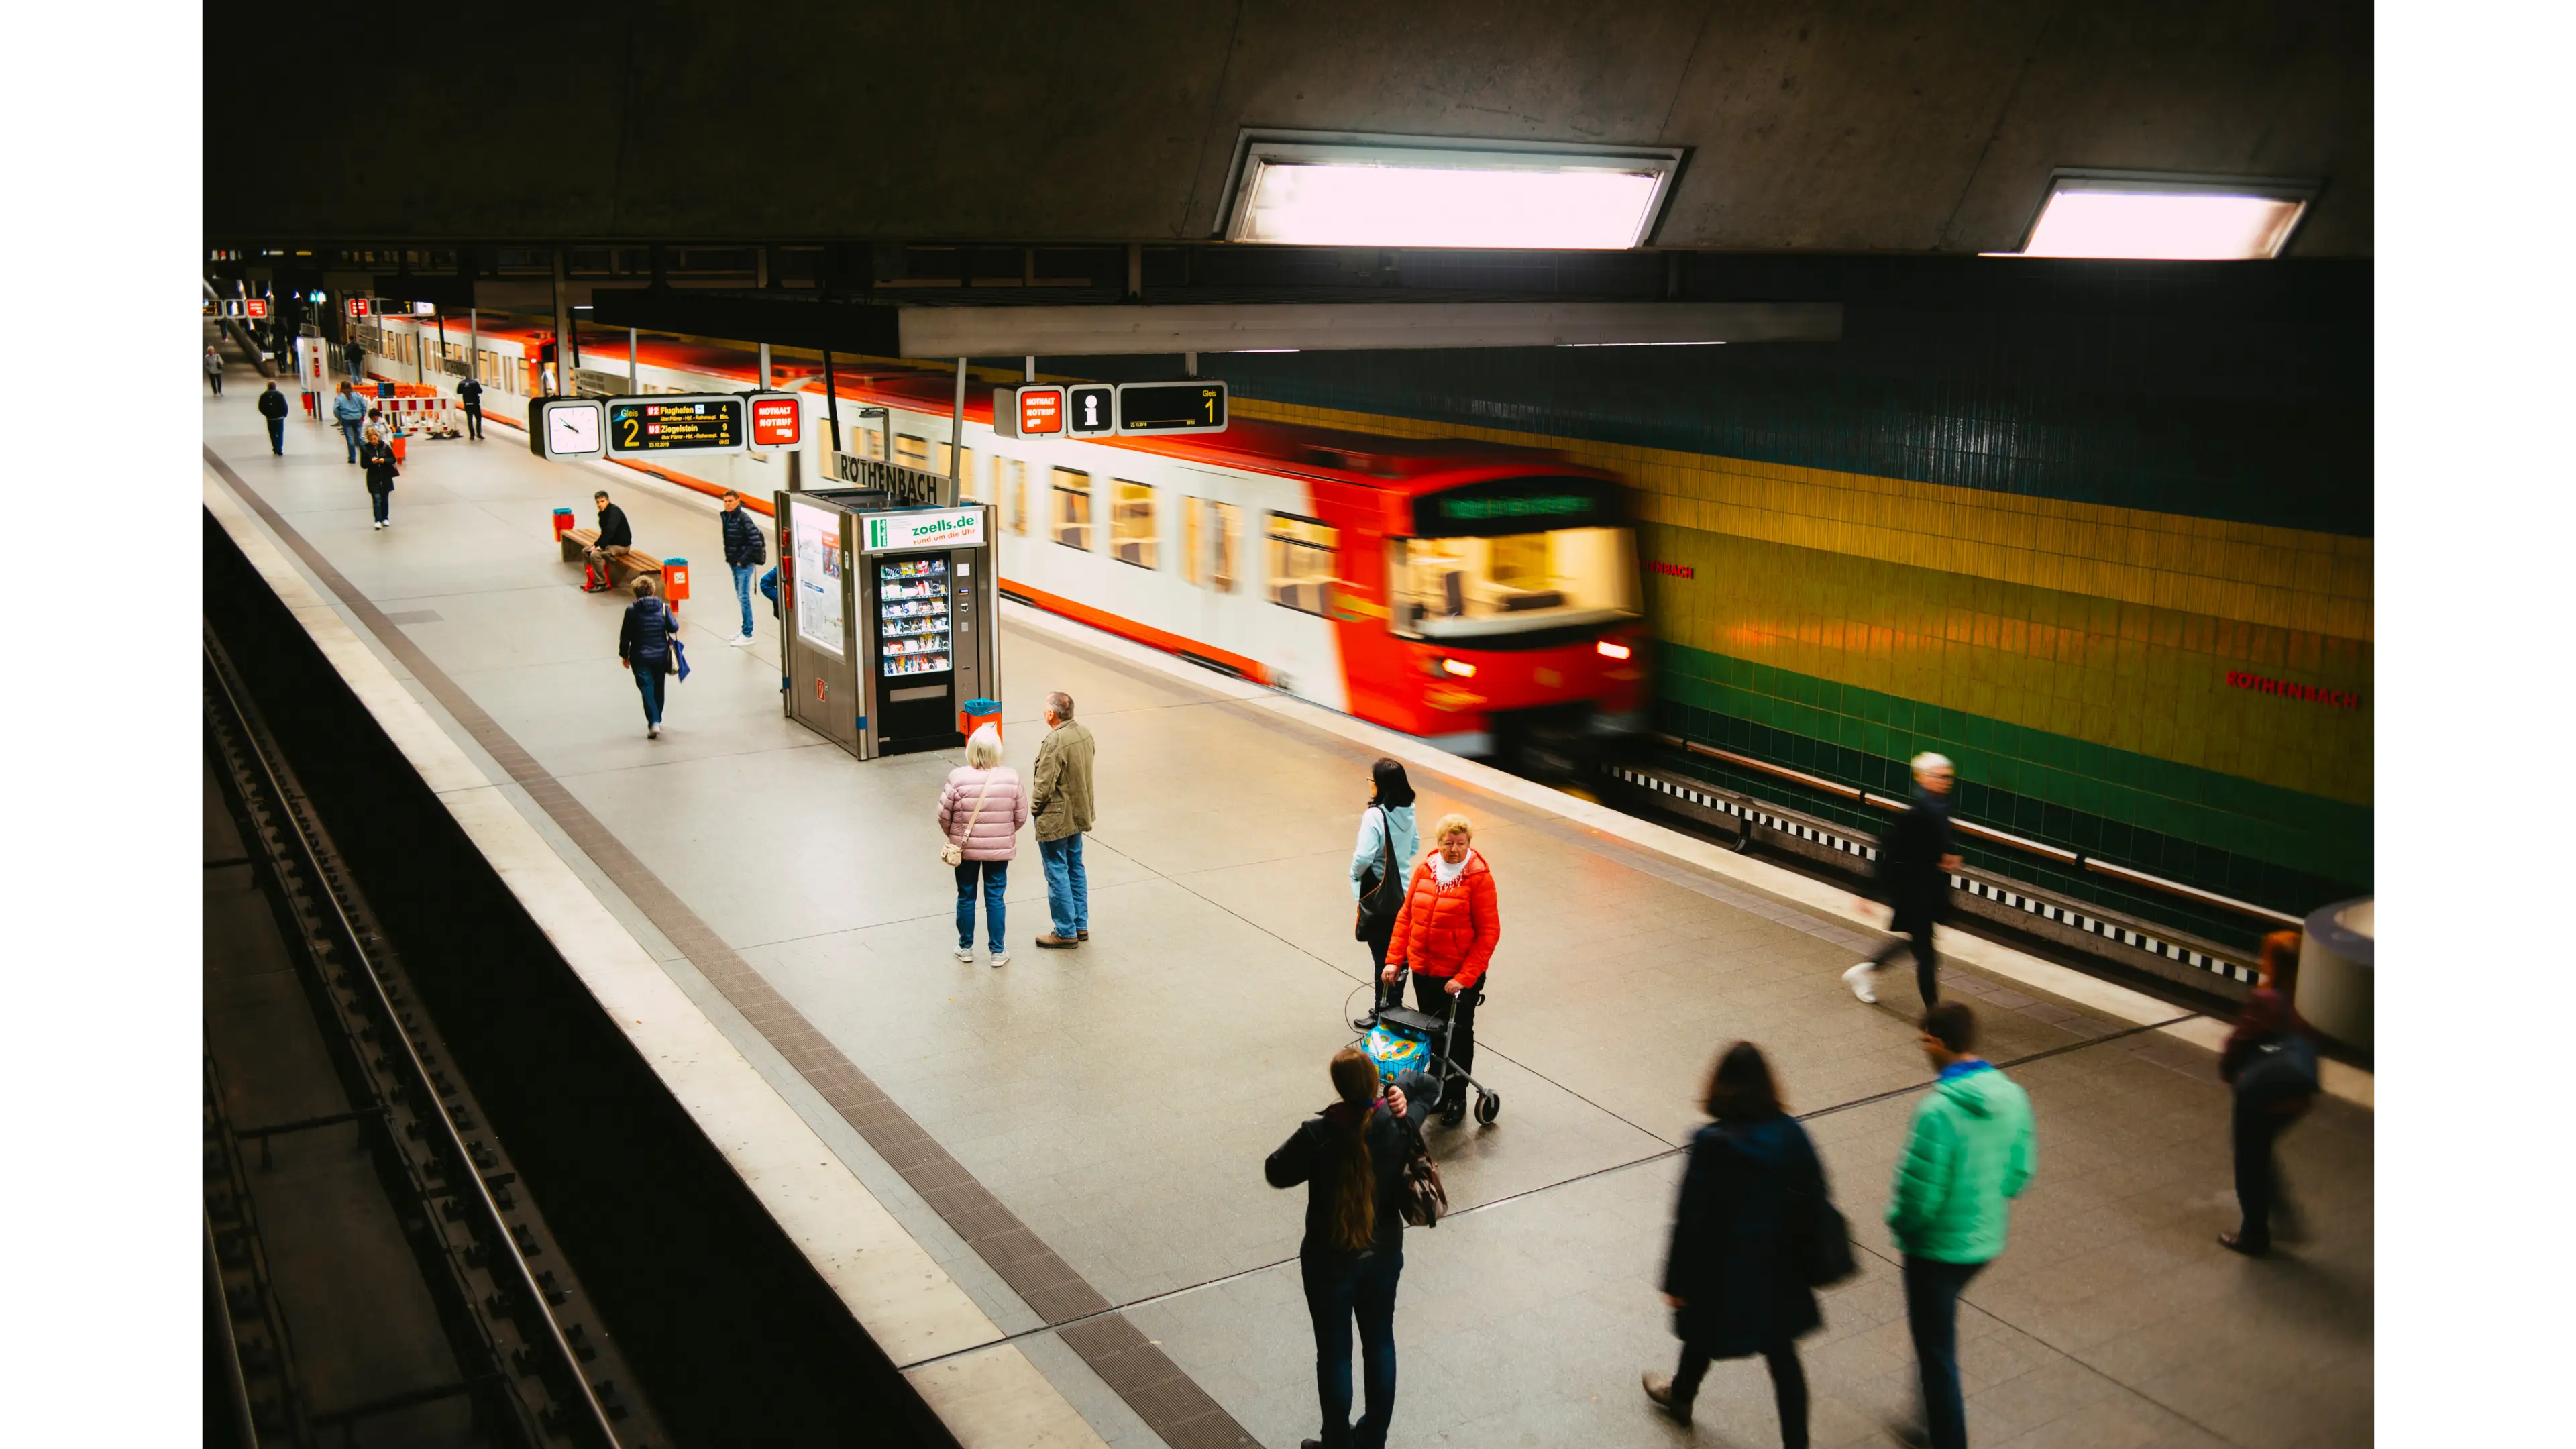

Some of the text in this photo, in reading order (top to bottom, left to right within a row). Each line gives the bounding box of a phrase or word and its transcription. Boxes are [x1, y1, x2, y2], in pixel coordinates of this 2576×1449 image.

[1026, 397, 1055, 406] NOTHALT
[621, 409, 639, 417] Gleis
[647, 406, 694, 416] U2 Flughafen
[722, 405, 727, 413] 4
[759, 407, 791, 415] NOTHALT
[1026, 408, 1055, 416] NOTRUF
[1205, 398, 1213, 423] 1
[722, 423, 728, 431] 9
[759, 417, 792, 427] NOTRUF
[624, 419, 639, 447] 2
[648, 424, 698, 435] U2 Ziegelstein
[841, 454, 937, 504] RÖTHENBACH
[912, 515, 974, 536] zoells.de
[913, 535, 931, 545] rund
[1643, 559, 1693, 580] HENBACH
[2226, 669, 2357, 710] RÖTHENBACH
